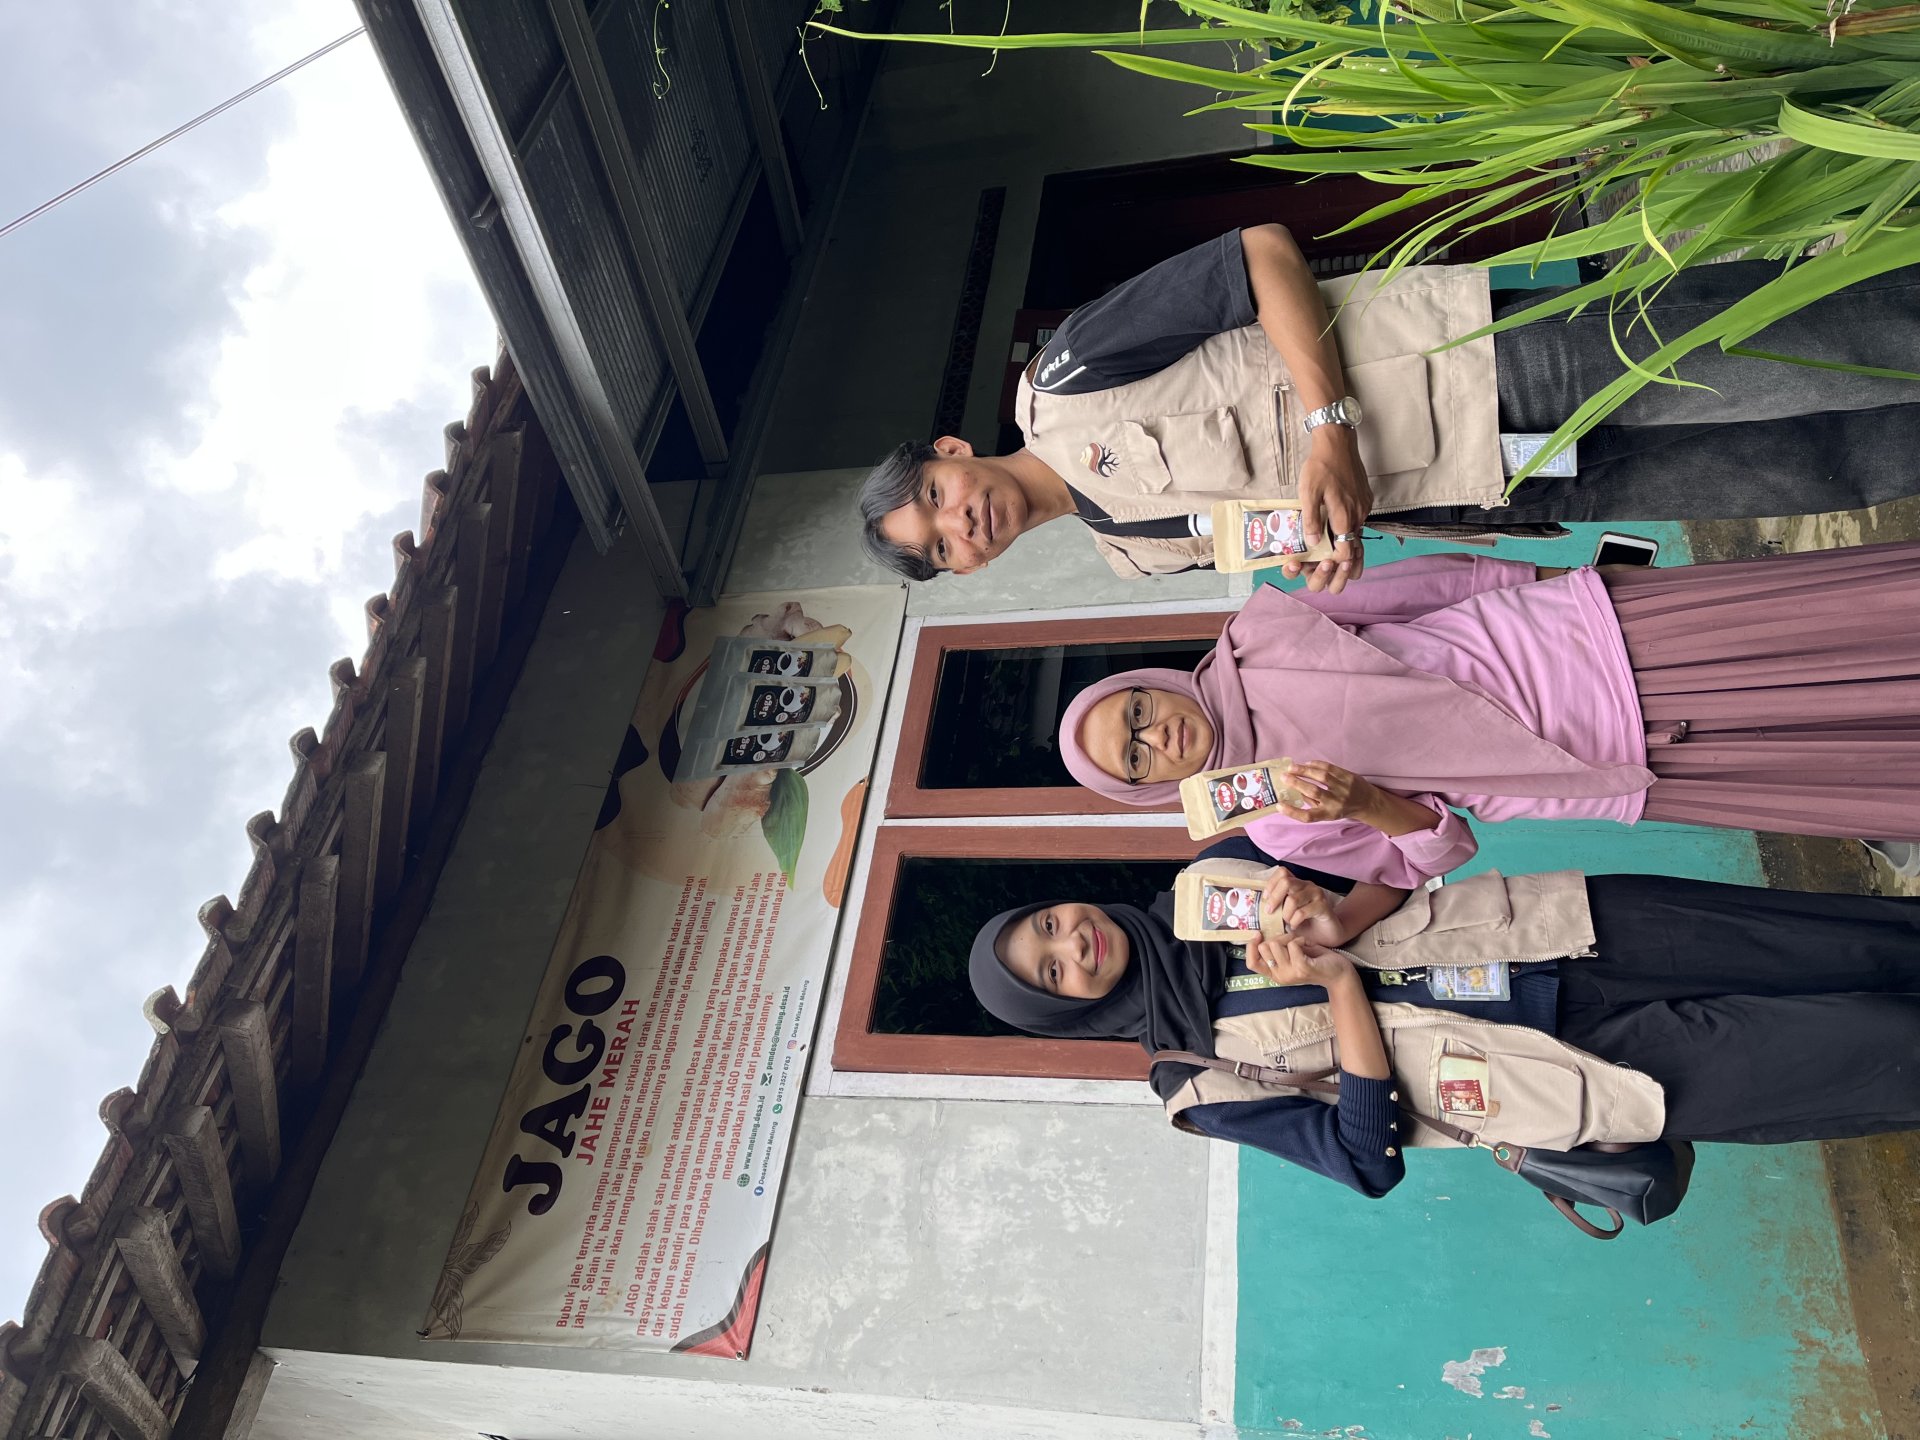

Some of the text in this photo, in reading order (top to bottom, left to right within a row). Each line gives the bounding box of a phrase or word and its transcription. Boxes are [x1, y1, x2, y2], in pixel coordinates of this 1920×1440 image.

[1252, 521, 1262, 548] Jago
[736, 736, 750, 757] Jag
[759, 694, 772, 718] Jago
[1220, 785, 1232, 808] Jago
[1211, 895, 1221, 920] Jago
[1244, 977, 1264, 986] 2026
[502, 955, 626, 1216] JAGO
[556, 876, 695, 1328] Bubuk jahe ternyata mampu memperlancar sirkulasi darah dan menurunkan kadar kolesterol
[571, 876, 709, 1329] jahat. Selain itu, bubuk jahe juga mampu mencegah penyumbatan di dalam pembuluh darah.
[576, 999, 641, 1166] JAHE MERAH
[596, 899, 716, 1296] Hal ini akan mengurangi risiko munculnya gangguan stroke dan penyakit jantung.
[623, 886, 745, 1316] JAGO adalah salah satu produk andalan dari Desa Melung yang merupakan inovasi dari
[637, 873, 762, 1336] masyarakat desa untuk membantu mengatasi berbagai penyakit. Dengan mengolah hasil Jahe
[651, 872, 777, 1337] dari kebun sendiri para warga membuat serbuk Jahe Merah yang tak kalah dengan merk yang
[669, 872, 789, 1339] sudah terkenal. Diharapkan dengan adanya JAGO masyarakat dapat memperoleh manfaat dan
[722, 992, 774, 1180] mendapatkan hasil dari penjualannya.
[766, 986, 791, 1070] pemdes@melung.desa.id
[743, 1095, 766, 1170] www.melung.desa.id
